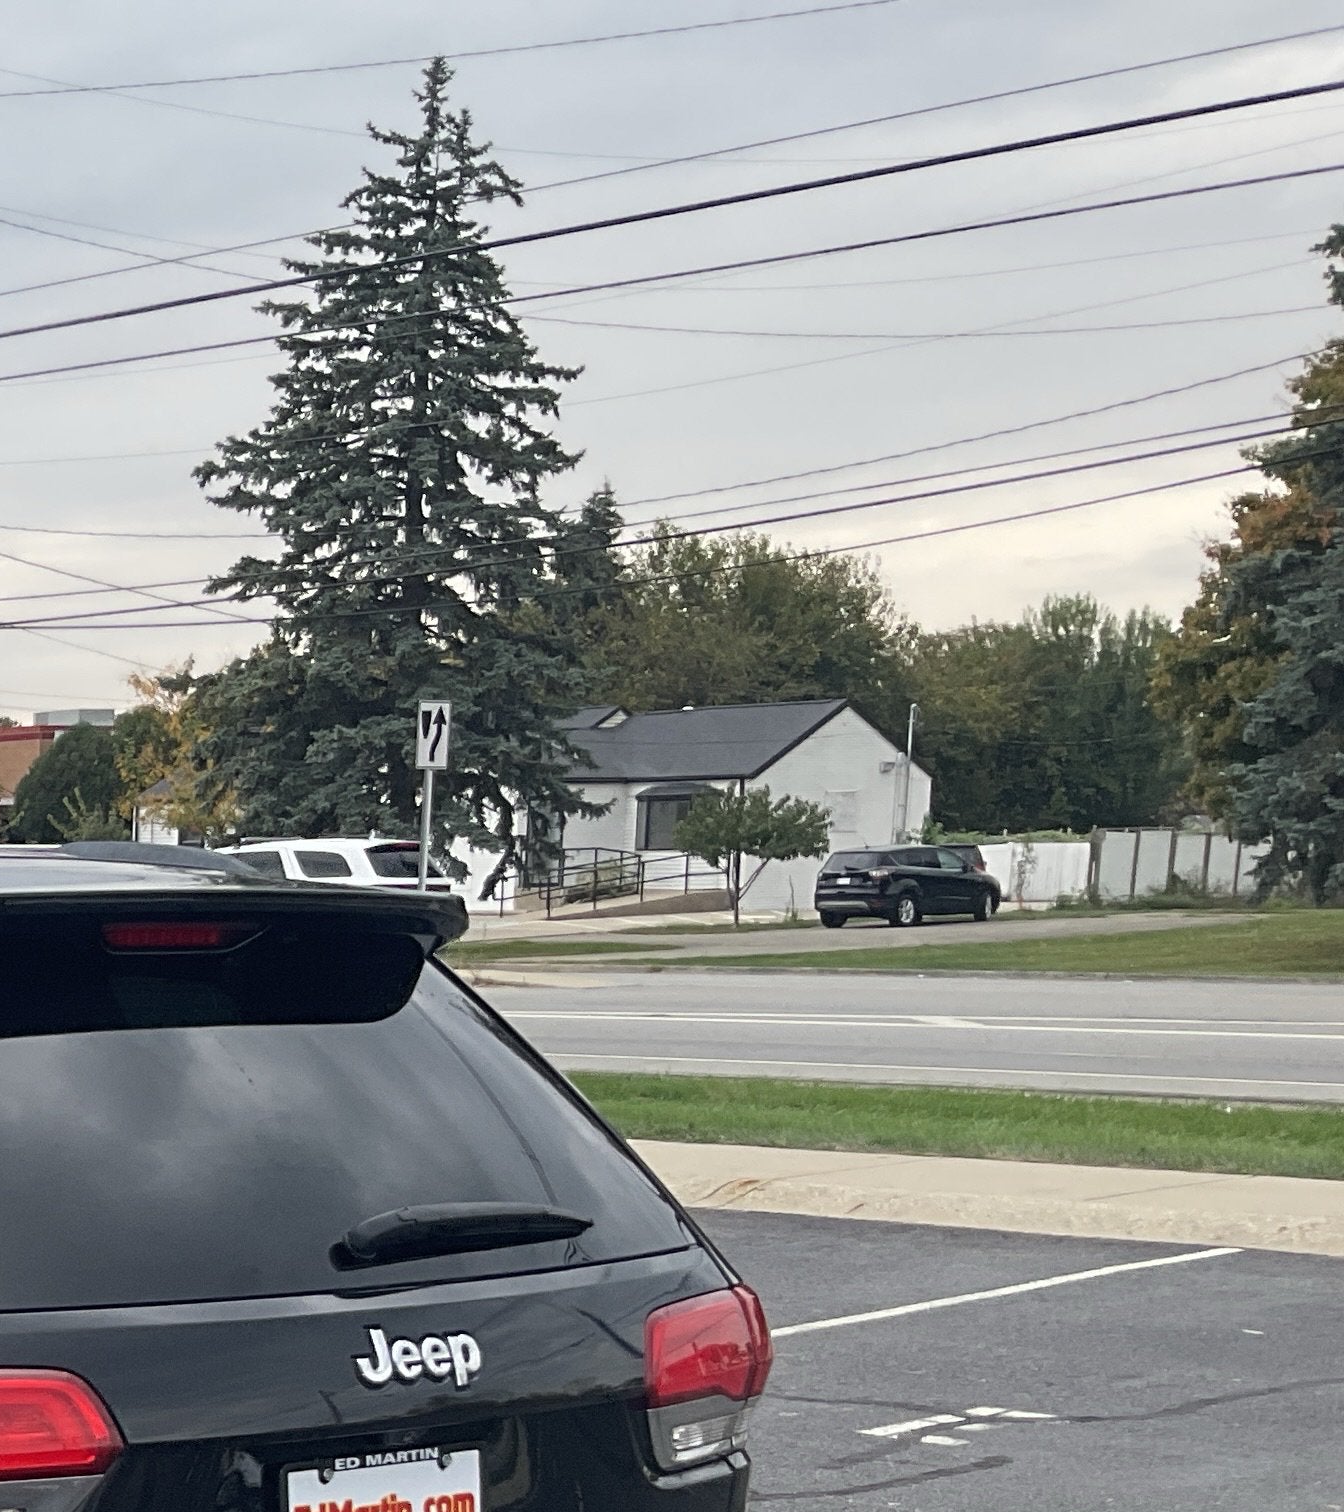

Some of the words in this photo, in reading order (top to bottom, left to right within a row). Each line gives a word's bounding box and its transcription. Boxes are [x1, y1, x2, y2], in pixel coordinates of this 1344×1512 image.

[355, 1327, 481, 1387] Jeep
[334, 1456, 360, 1471] ED
[365, 1447, 439, 1467] MARTIN
